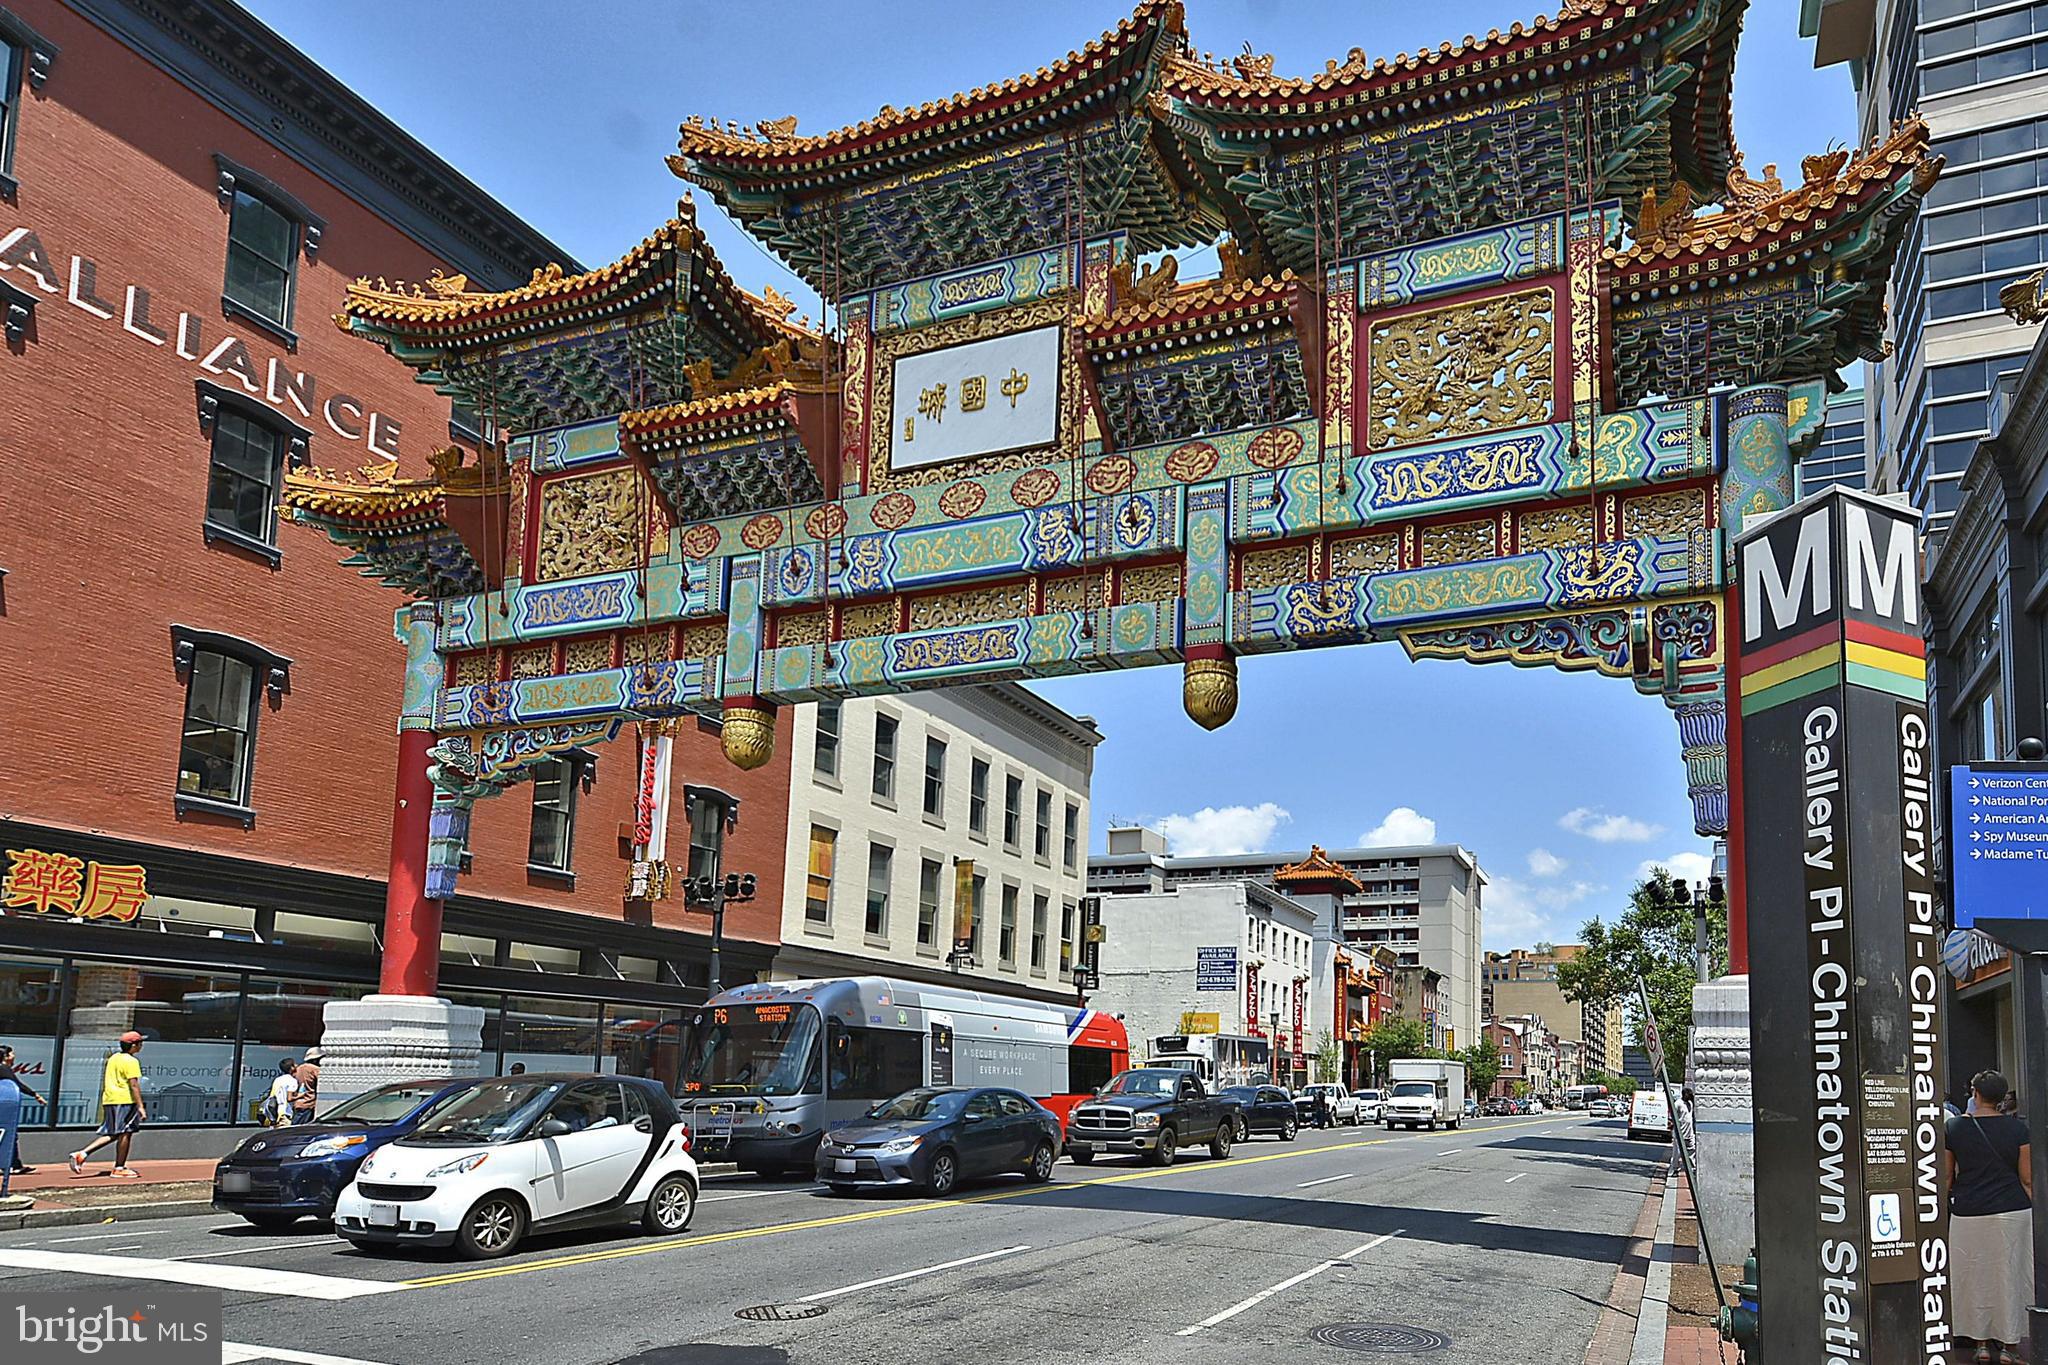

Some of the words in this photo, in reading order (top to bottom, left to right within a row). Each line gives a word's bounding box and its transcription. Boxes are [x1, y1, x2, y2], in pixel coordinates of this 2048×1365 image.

[0, 226, 402, 461] ALLIANCE
[1844, 502, 1918, 625] M
[1744, 507, 1832, 643] M
[1804, 705, 1839, 870] Gallery
[1982, 778, 2023, 788] Verizon
[1901, 713, 1929, 877] Gallery
[1982, 796, 2028, 806] National
[1984, 814, 2035, 824] American
[1983, 831, 2004, 844] Spy
[1984, 848, 2034, 859] Madame
[2, 848, 151, 922] 藥房
[755, 1005, 791, 1015] ANACOSTIA
[714, 1008, 728, 1025] P6
[759, 1013, 787, 1023] STATION
[970, 1049, 997, 1059] SECURE
[156, 1065, 178, 1077] the
[180, 1067, 221, 1077] corner
[979, 1065, 1001, 1075] EVERY
